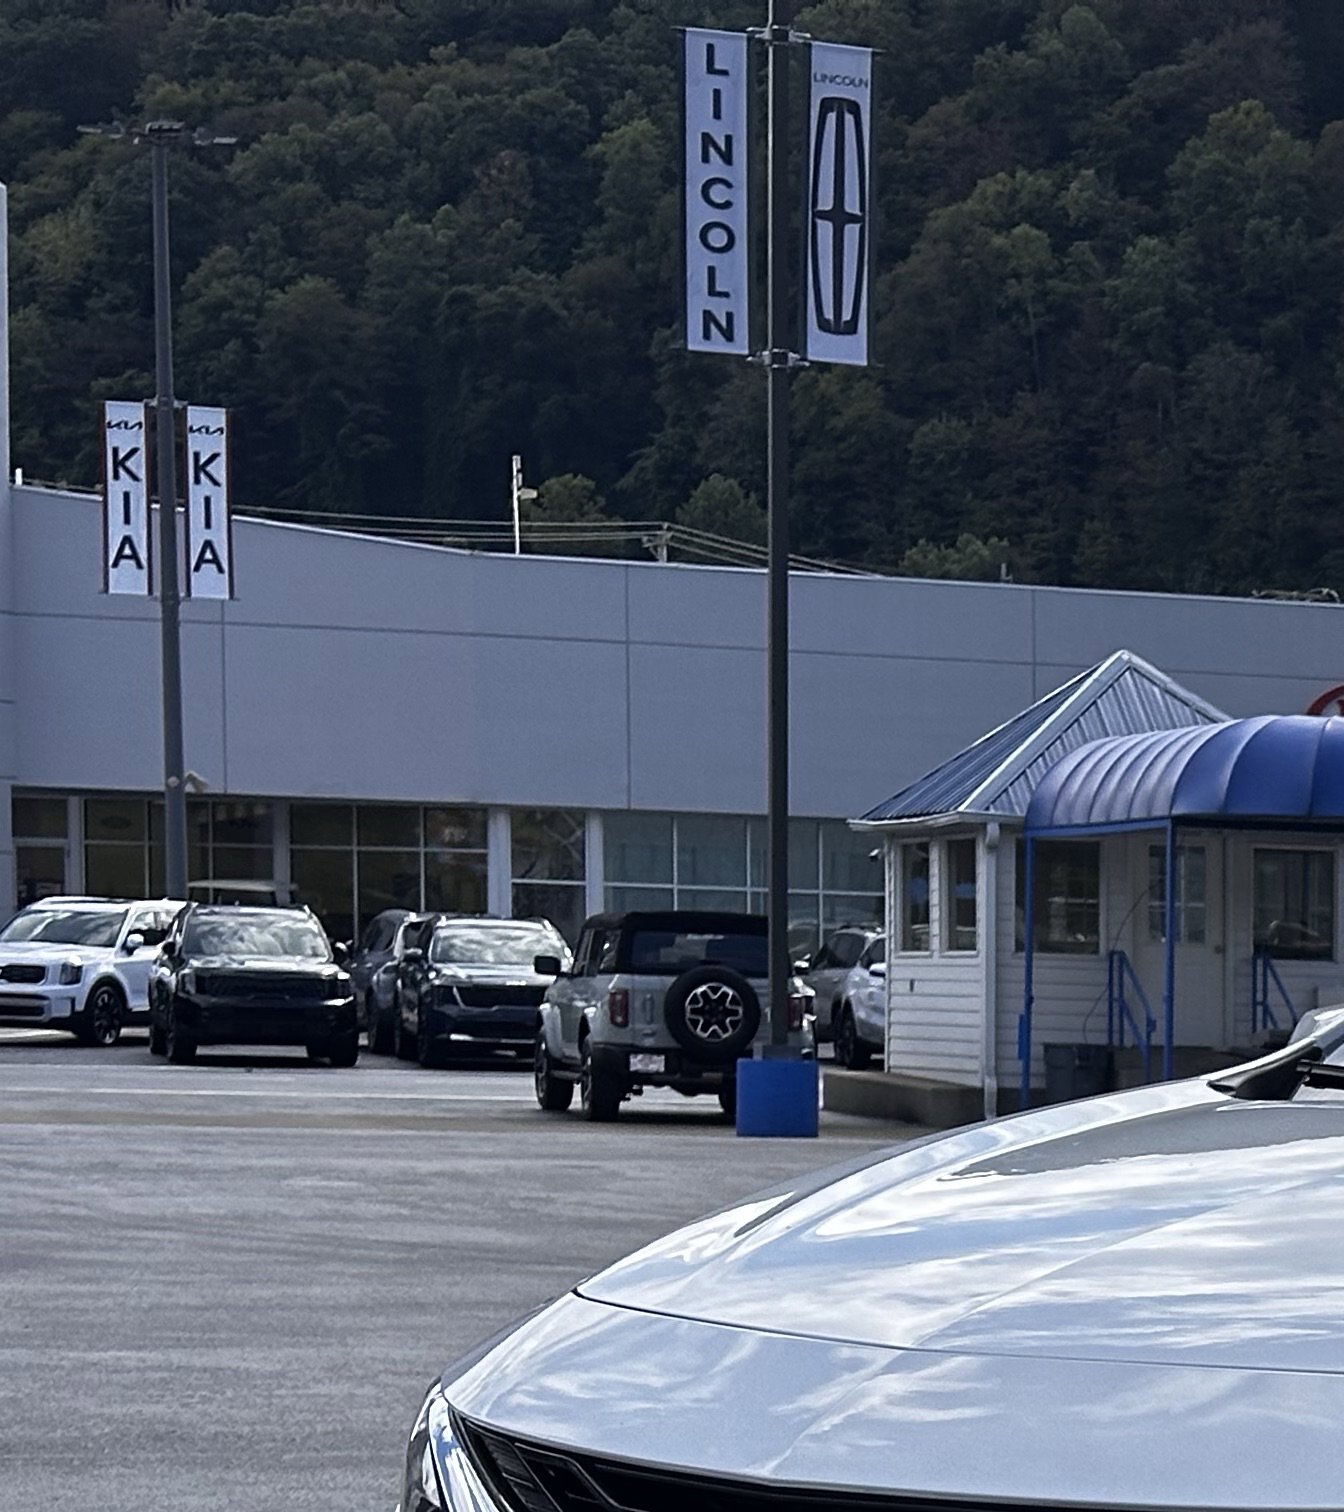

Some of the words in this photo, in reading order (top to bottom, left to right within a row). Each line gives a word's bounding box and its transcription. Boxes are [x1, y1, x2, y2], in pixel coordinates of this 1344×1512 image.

[812, 71, 869, 89] LINCOLN
[699, 42, 736, 343] LINCOLN
[111, 446, 144, 570] KIA
[193, 451, 225, 574] KIA
